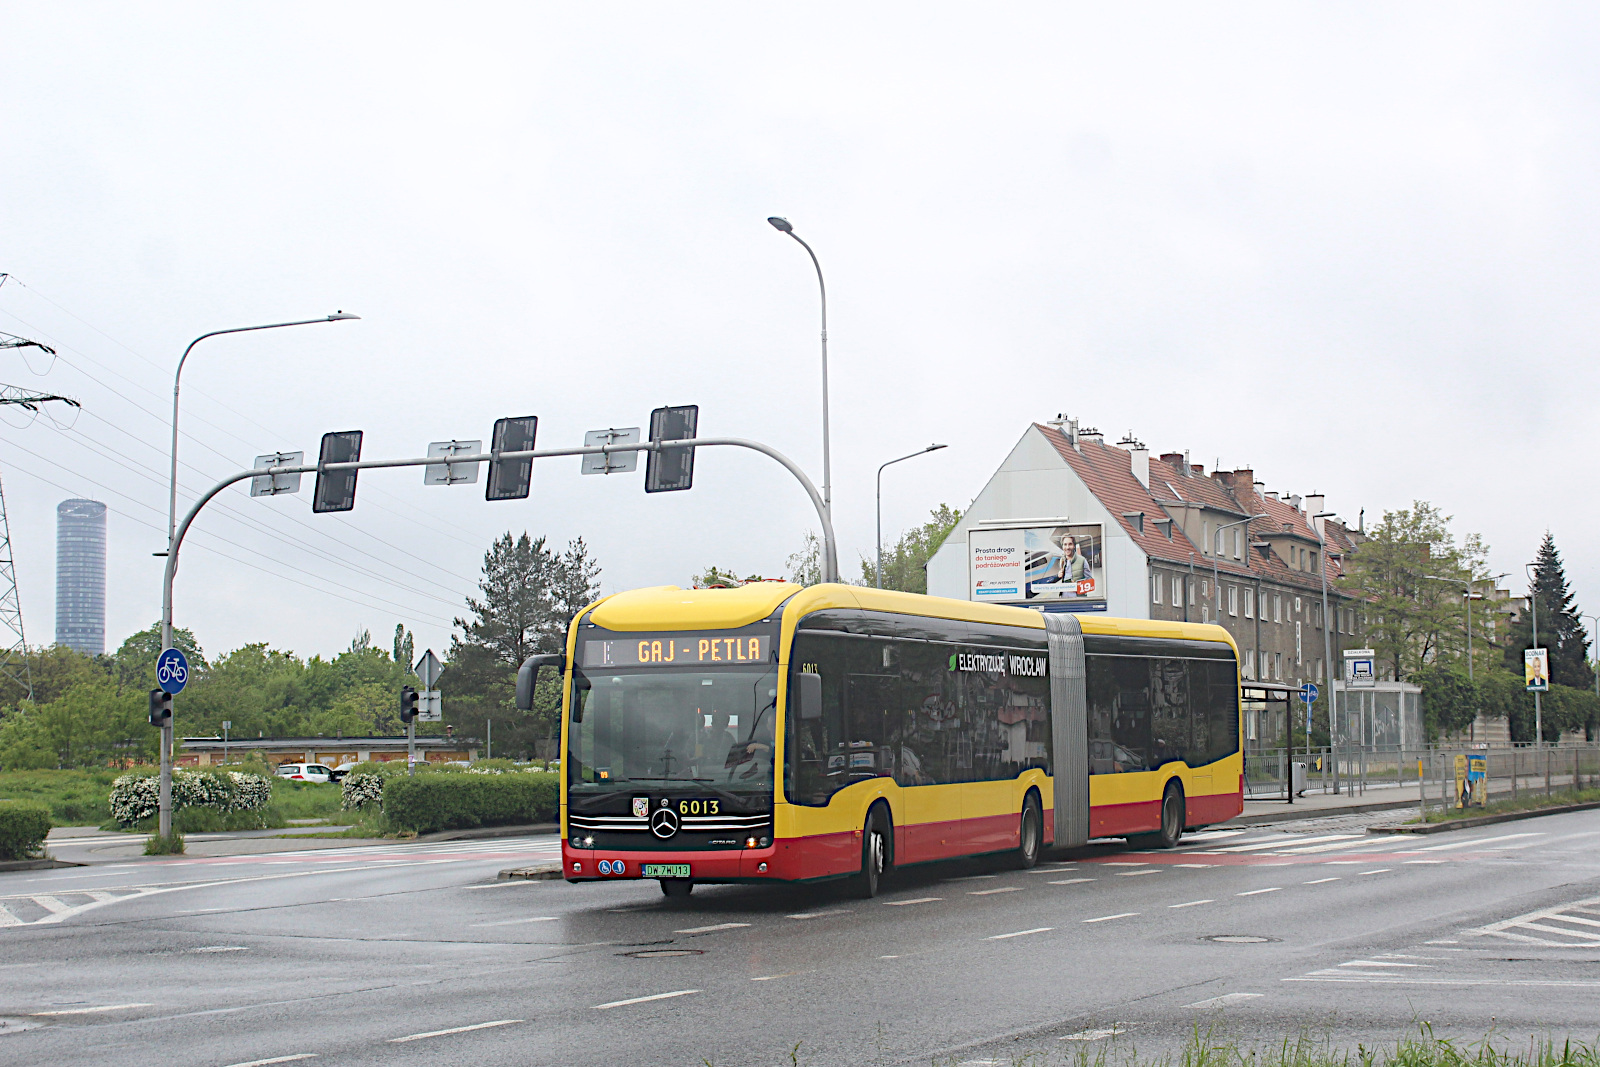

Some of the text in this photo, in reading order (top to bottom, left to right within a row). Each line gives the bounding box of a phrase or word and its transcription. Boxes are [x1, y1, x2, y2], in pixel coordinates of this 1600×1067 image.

[996, 547, 1015, 555] droga
[1080, 583, 1091, 593] 19
[638, 640, 675, 662] GAJ
[802, 662, 818, 674] 6013
[958, 653, 1047, 678] ELEKTRYZUJĘ WROCŁAW
[679, 800, 720, 815] 6013
[647, 865, 660, 875] DW
